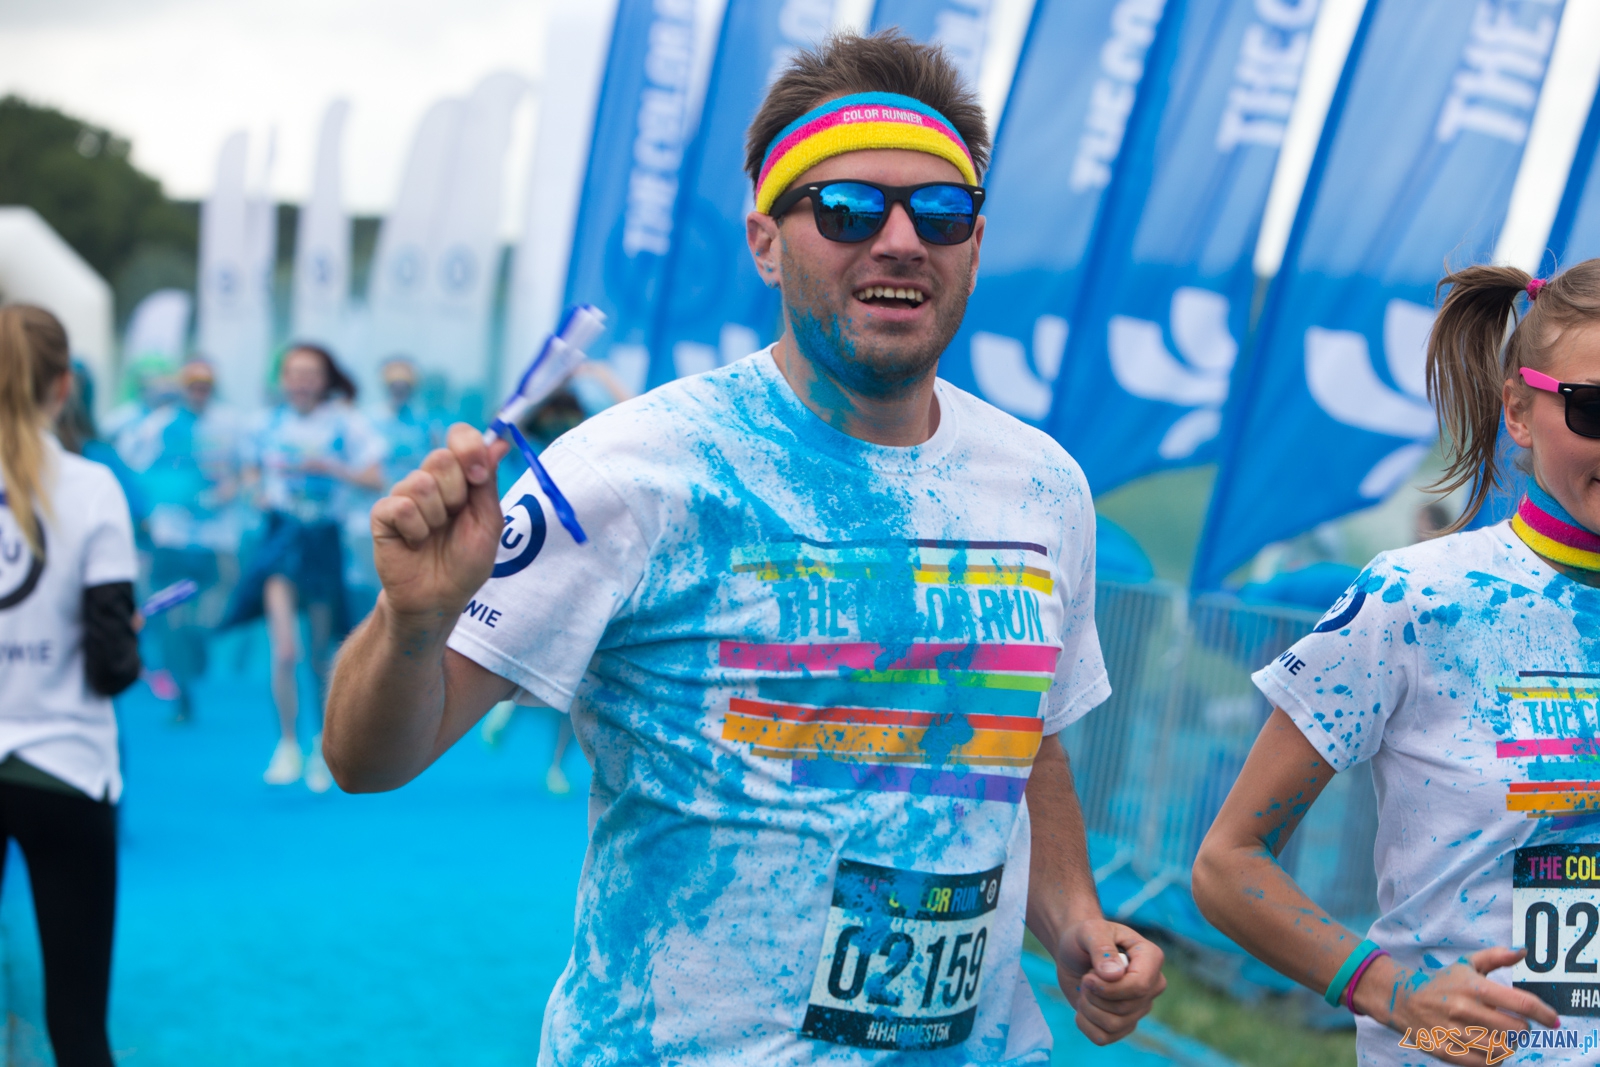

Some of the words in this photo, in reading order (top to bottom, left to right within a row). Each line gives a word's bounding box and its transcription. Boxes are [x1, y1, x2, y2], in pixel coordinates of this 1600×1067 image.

[1216, 22, 1310, 154] THE
[1436, 0, 1557, 145] THE
[843, 109, 879, 122] COLOR
[881, 108, 923, 125] RUNNER
[773, 578, 850, 638] THE
[1522, 700, 1577, 735] THE
[1578, 700, 1600, 737] C
[1528, 856, 1563, 881] THE
[827, 925, 988, 1010] 02159
[1524, 901, 1600, 974] 02
